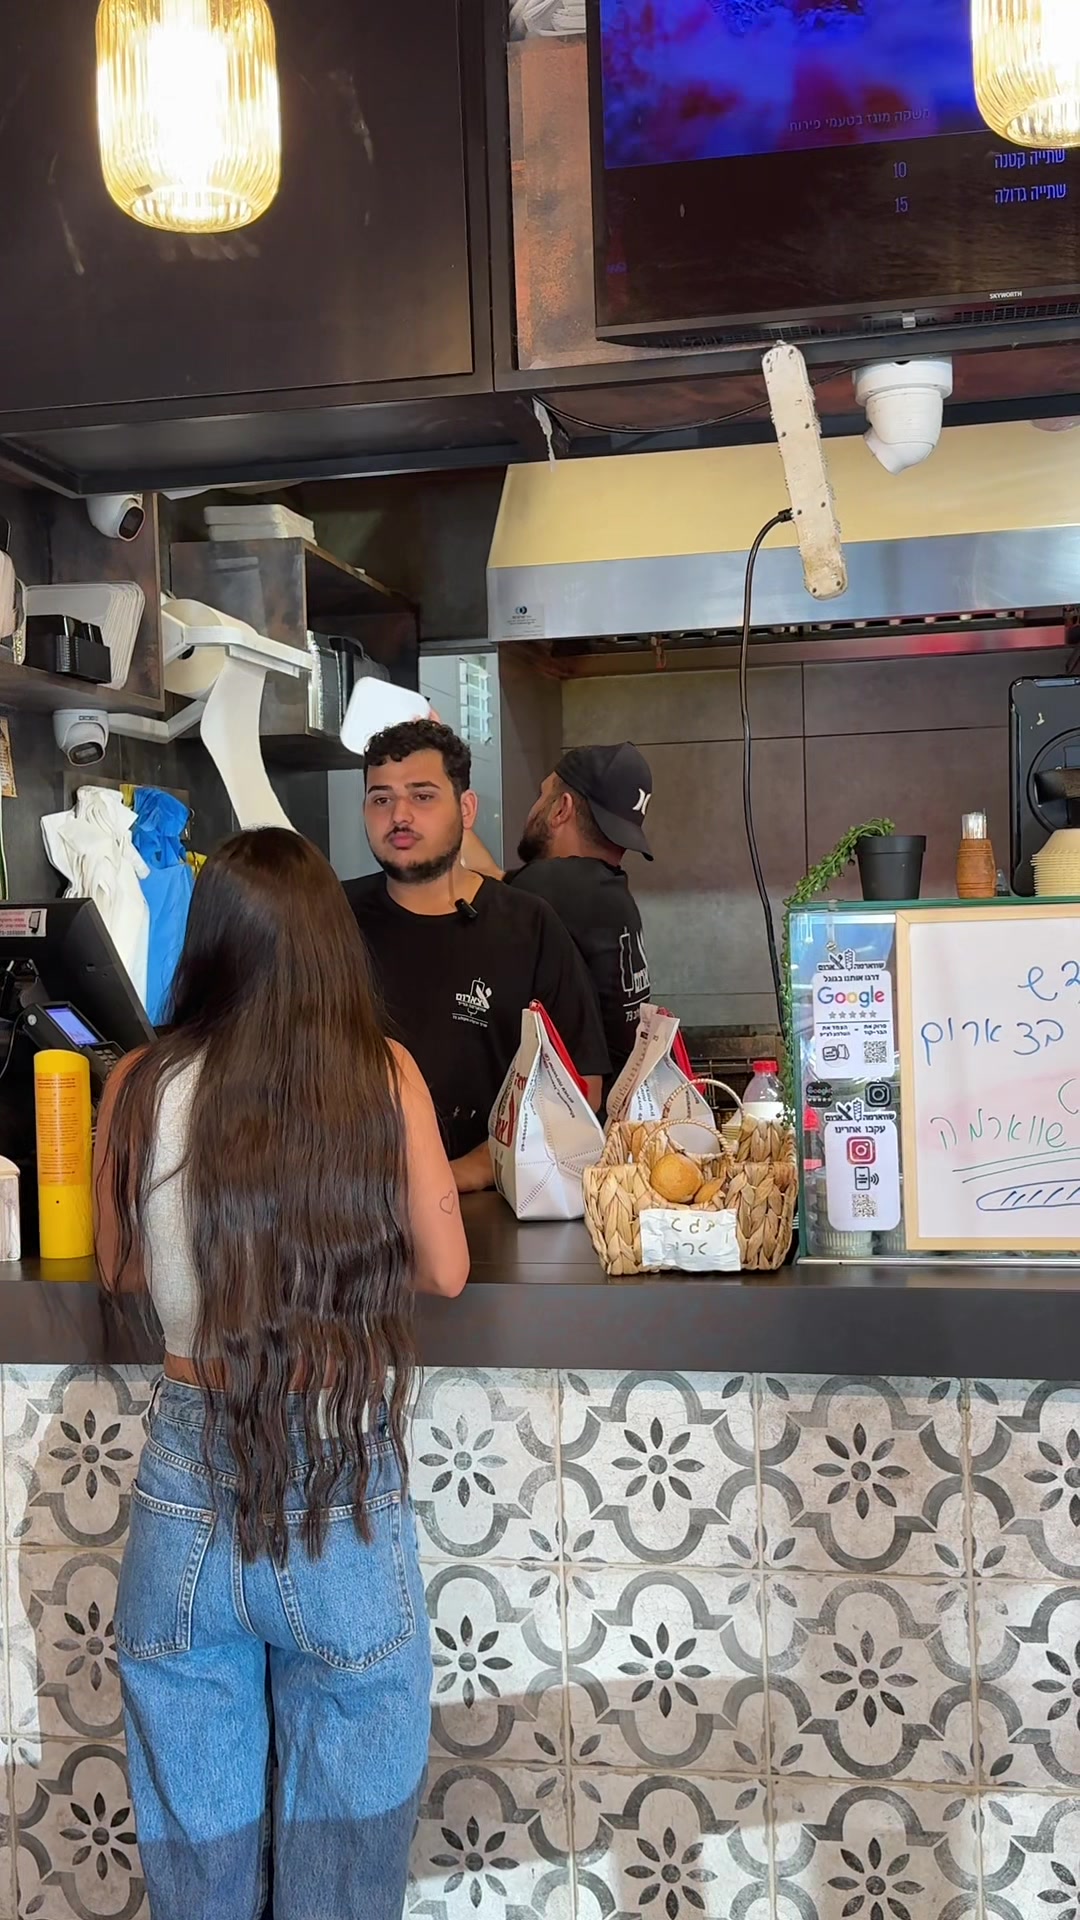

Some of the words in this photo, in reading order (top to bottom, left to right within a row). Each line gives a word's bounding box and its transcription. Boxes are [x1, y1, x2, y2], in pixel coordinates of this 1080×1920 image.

[994, 151, 1026, 169] קטנה
[1029, 148, 1066, 166] שתייה
[893, 161, 907, 178] 10
[994, 186, 1028, 204] גדולה
[1030, 183, 1067, 201] שתייה
[895, 196, 909, 213] 15
[989, 290, 1023, 300] SKYWORTH
[817, 985, 885, 1008] Google
[865, 1125, 886, 1135] עקבו
[930, 1108, 1067, 1150] שווארמה
